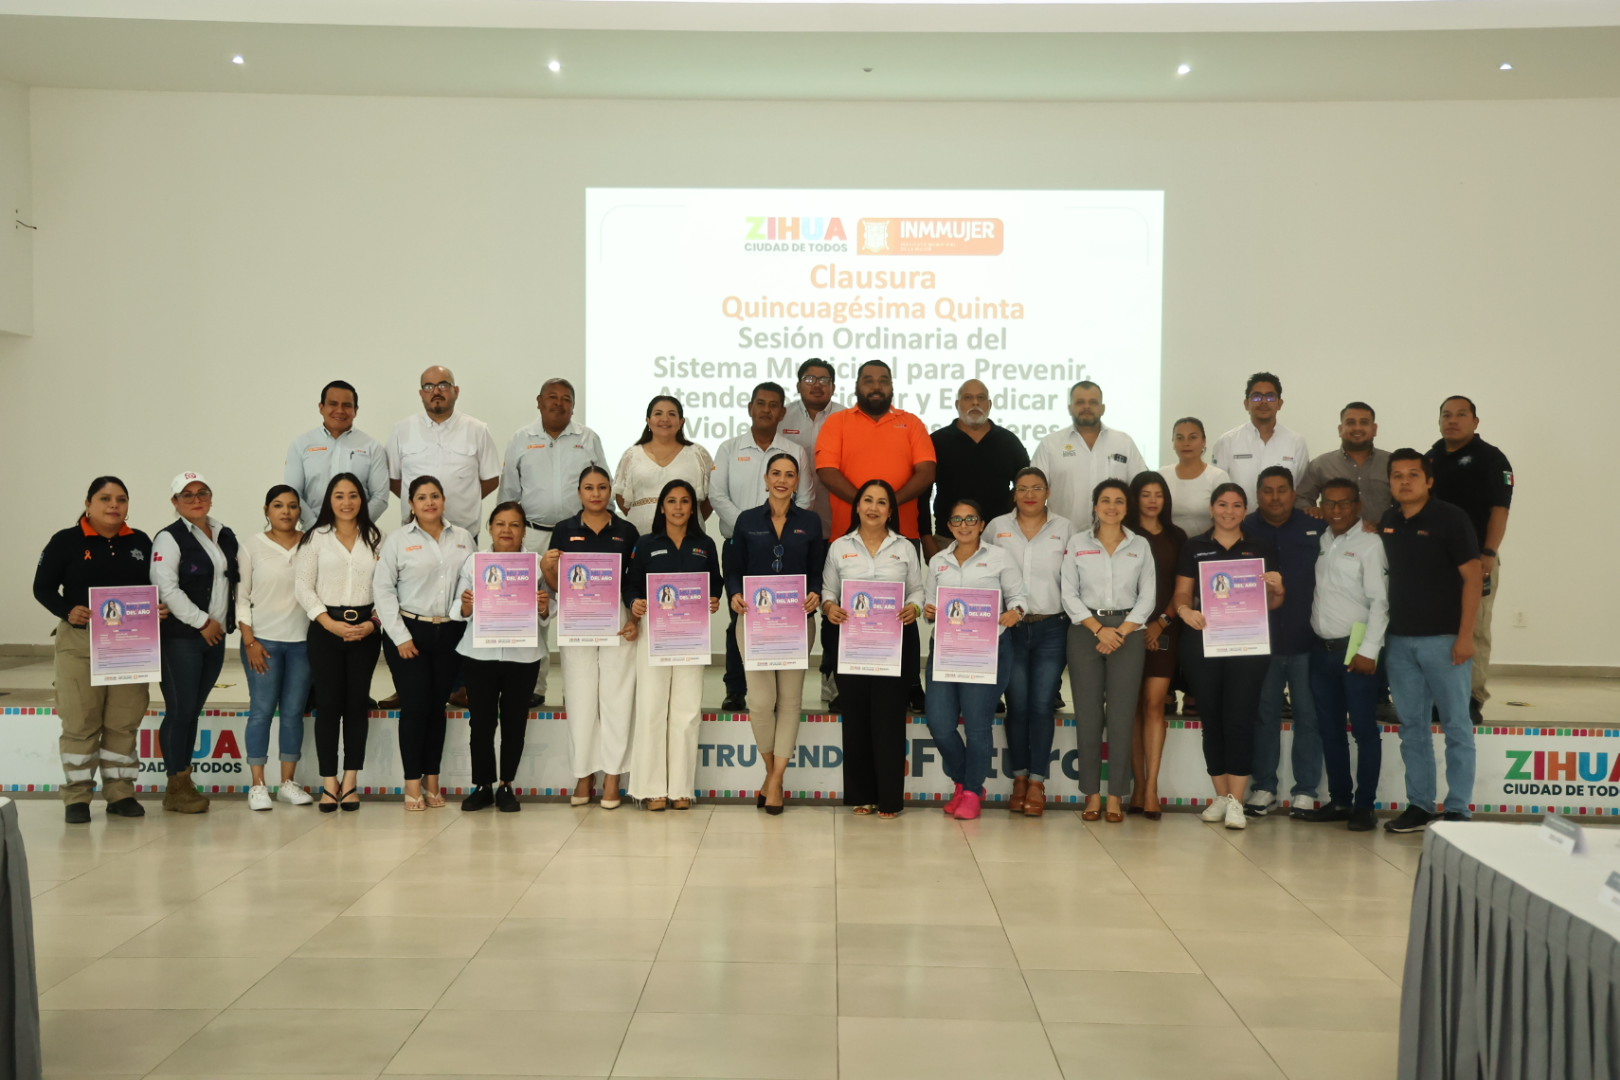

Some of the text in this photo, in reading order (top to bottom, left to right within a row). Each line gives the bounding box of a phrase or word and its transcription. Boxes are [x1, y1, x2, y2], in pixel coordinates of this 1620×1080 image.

[745, 215, 848, 241] ZIHUA
[900, 221, 995, 241] INMMUJER
[744, 242, 848, 252] CIUDAD DE TODOS
[810, 264, 936, 289] Clausura
[722, 296, 1025, 324] Quincuagésima Quinta
[738, 326, 1007, 350] Sesión Ordinaria del
[654, 356, 757, 378] Sistema
[908, 363, 964, 385] para
[916, 393, 931, 415] y
[940, 387, 1058, 410] Edicar
[685, 416, 751, 438] Viole
[140, 729, 242, 759] IUA
[191, 762, 242, 773] TODOS
[1503, 783, 1620, 797] CIUDAD DE TOD
